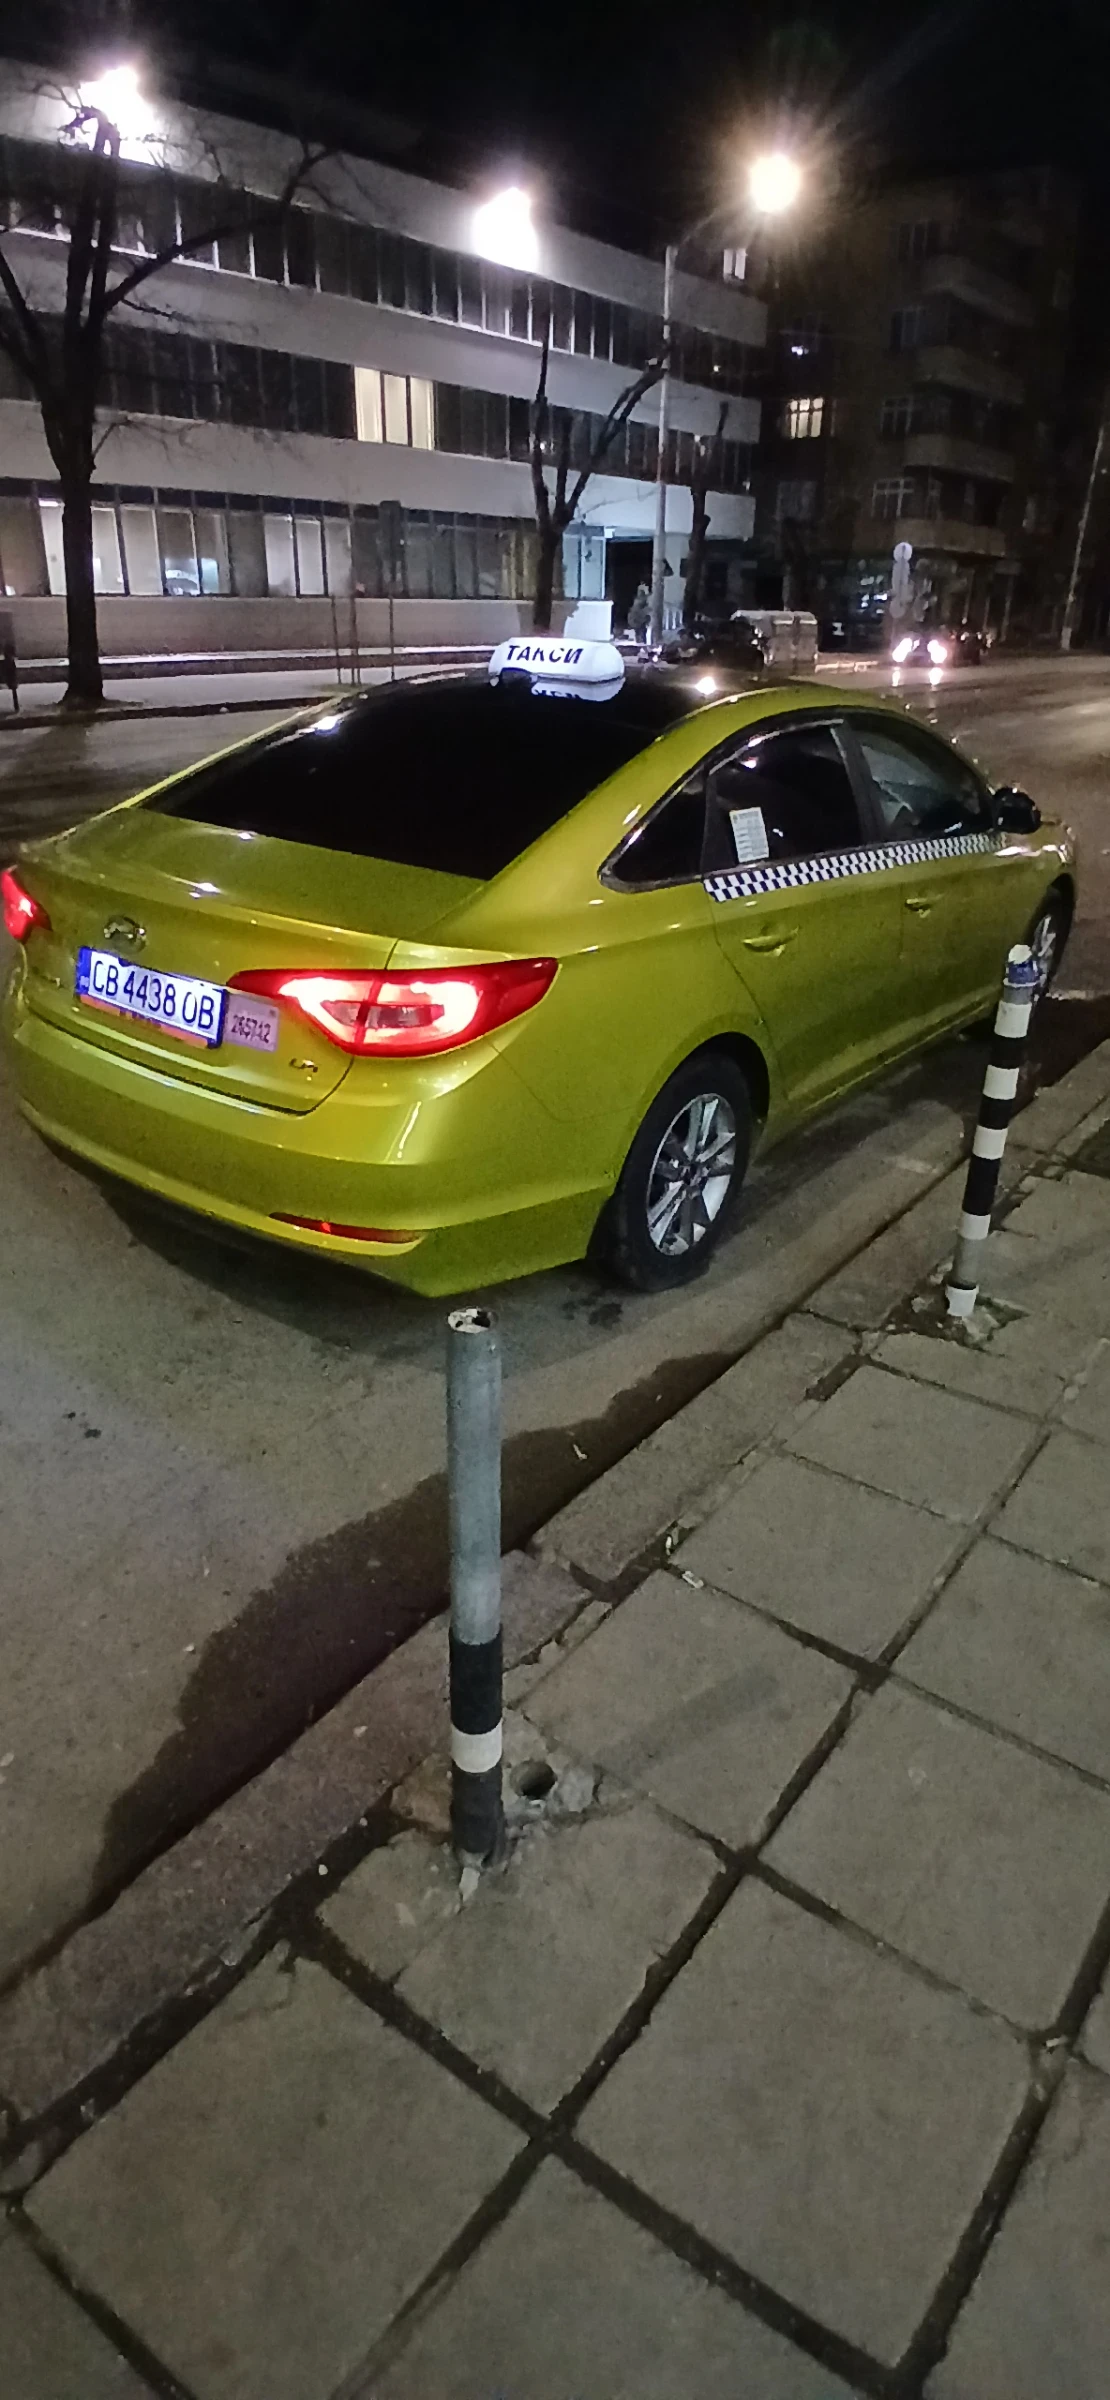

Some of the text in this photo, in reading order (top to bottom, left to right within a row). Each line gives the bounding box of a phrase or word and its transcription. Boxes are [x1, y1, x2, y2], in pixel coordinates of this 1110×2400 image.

[506, 645, 584, 664] ТАКСИ
[93, 960, 119, 997] CB
[123, 971, 176, 1017] 4438
